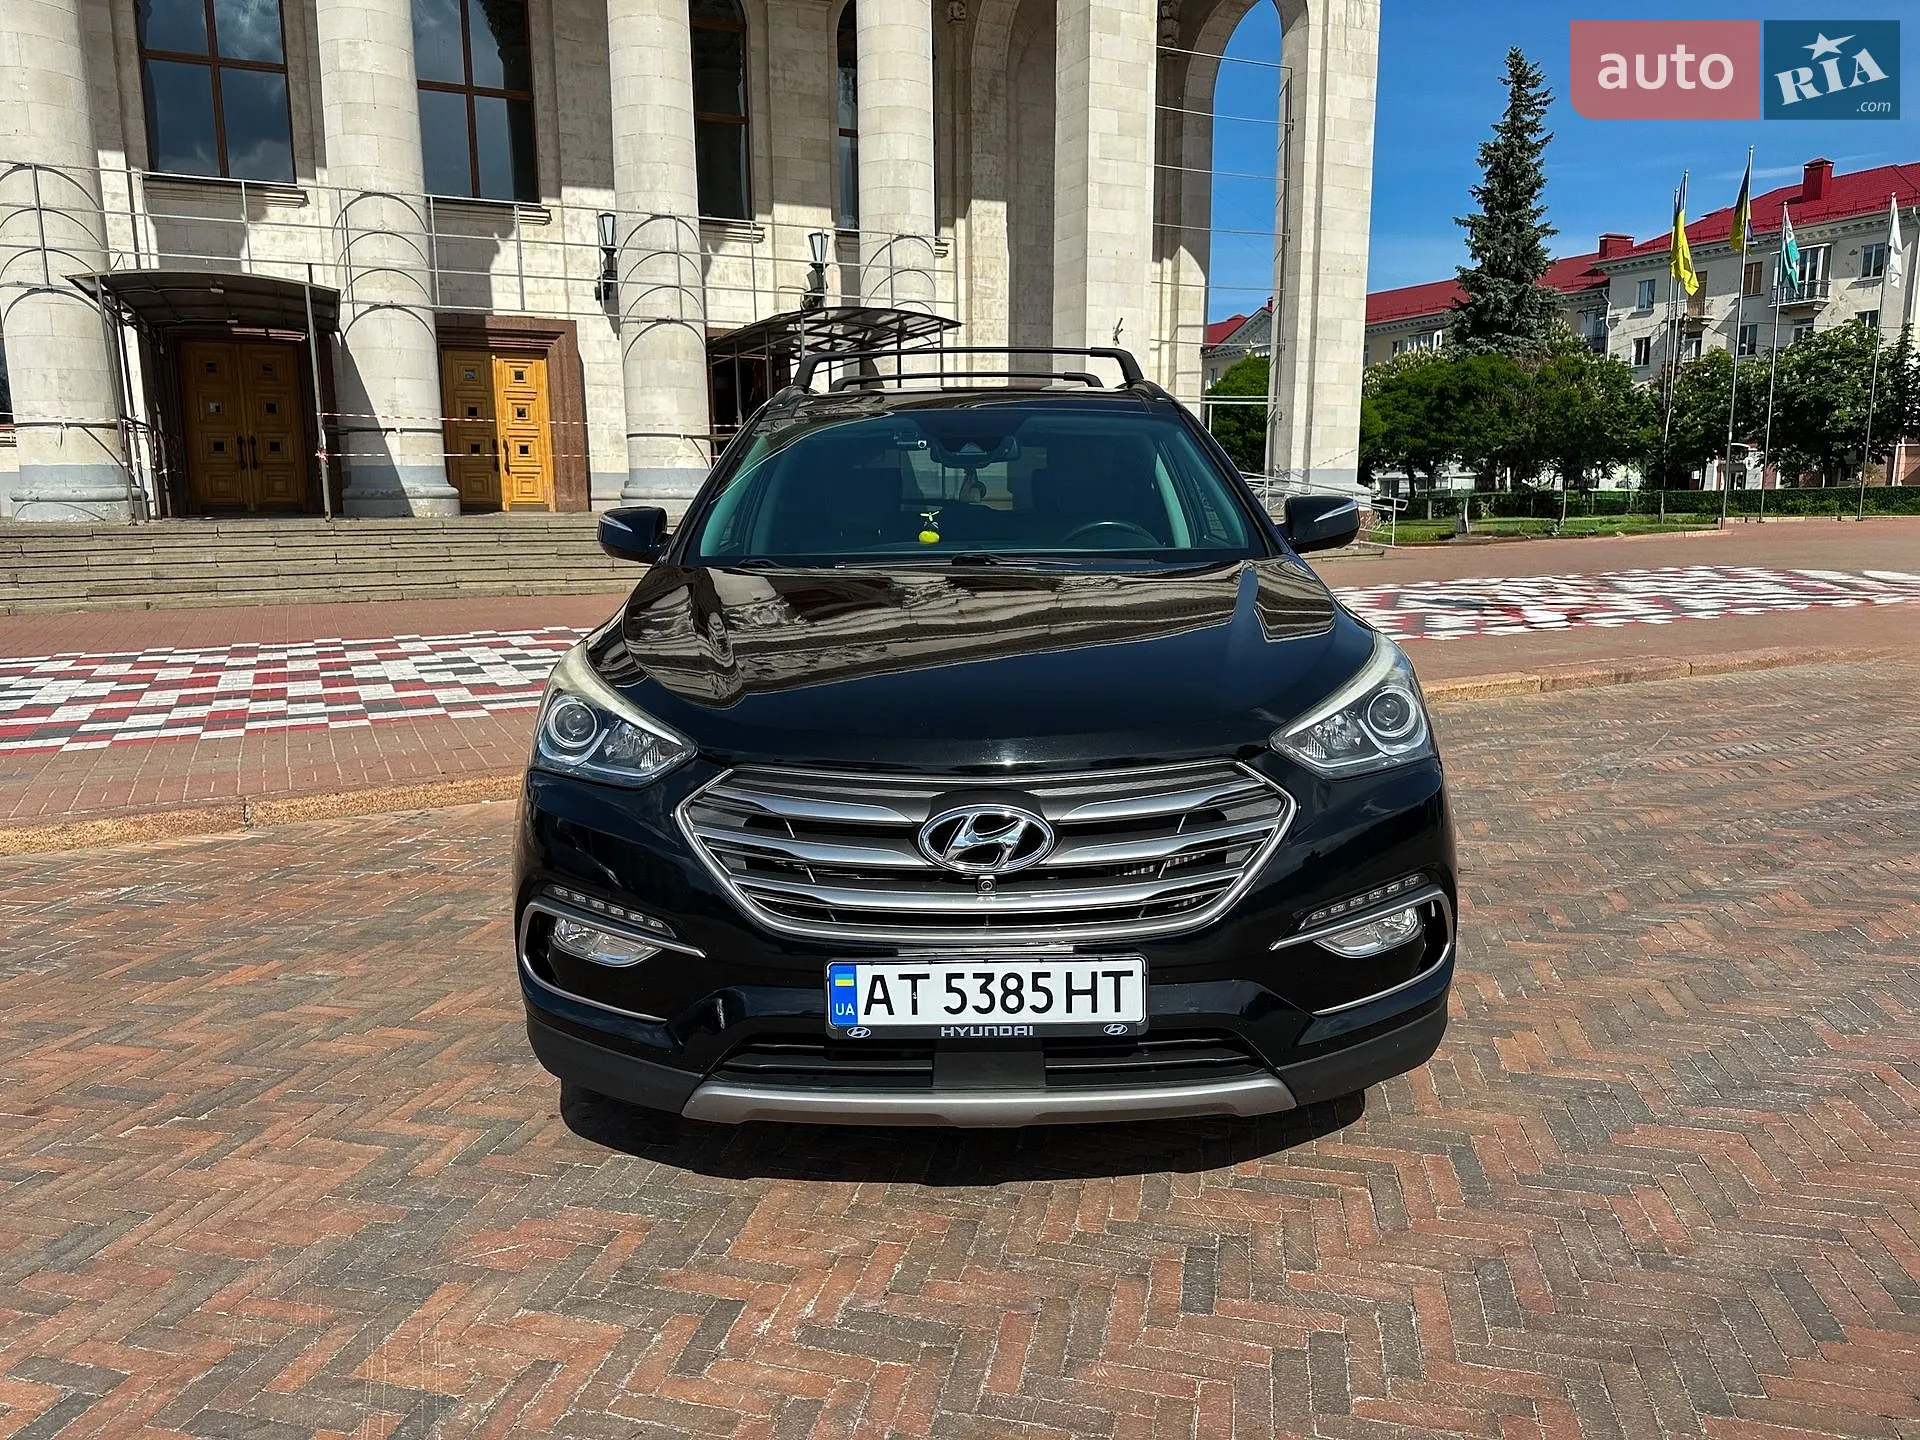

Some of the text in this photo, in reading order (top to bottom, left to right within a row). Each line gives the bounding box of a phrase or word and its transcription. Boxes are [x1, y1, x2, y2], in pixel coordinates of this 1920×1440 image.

[863, 969, 1134, 1016] AT 5385 HT
[835, 1003, 856, 1016] UA
[940, 1025, 1034, 1038] HYUNDAI
